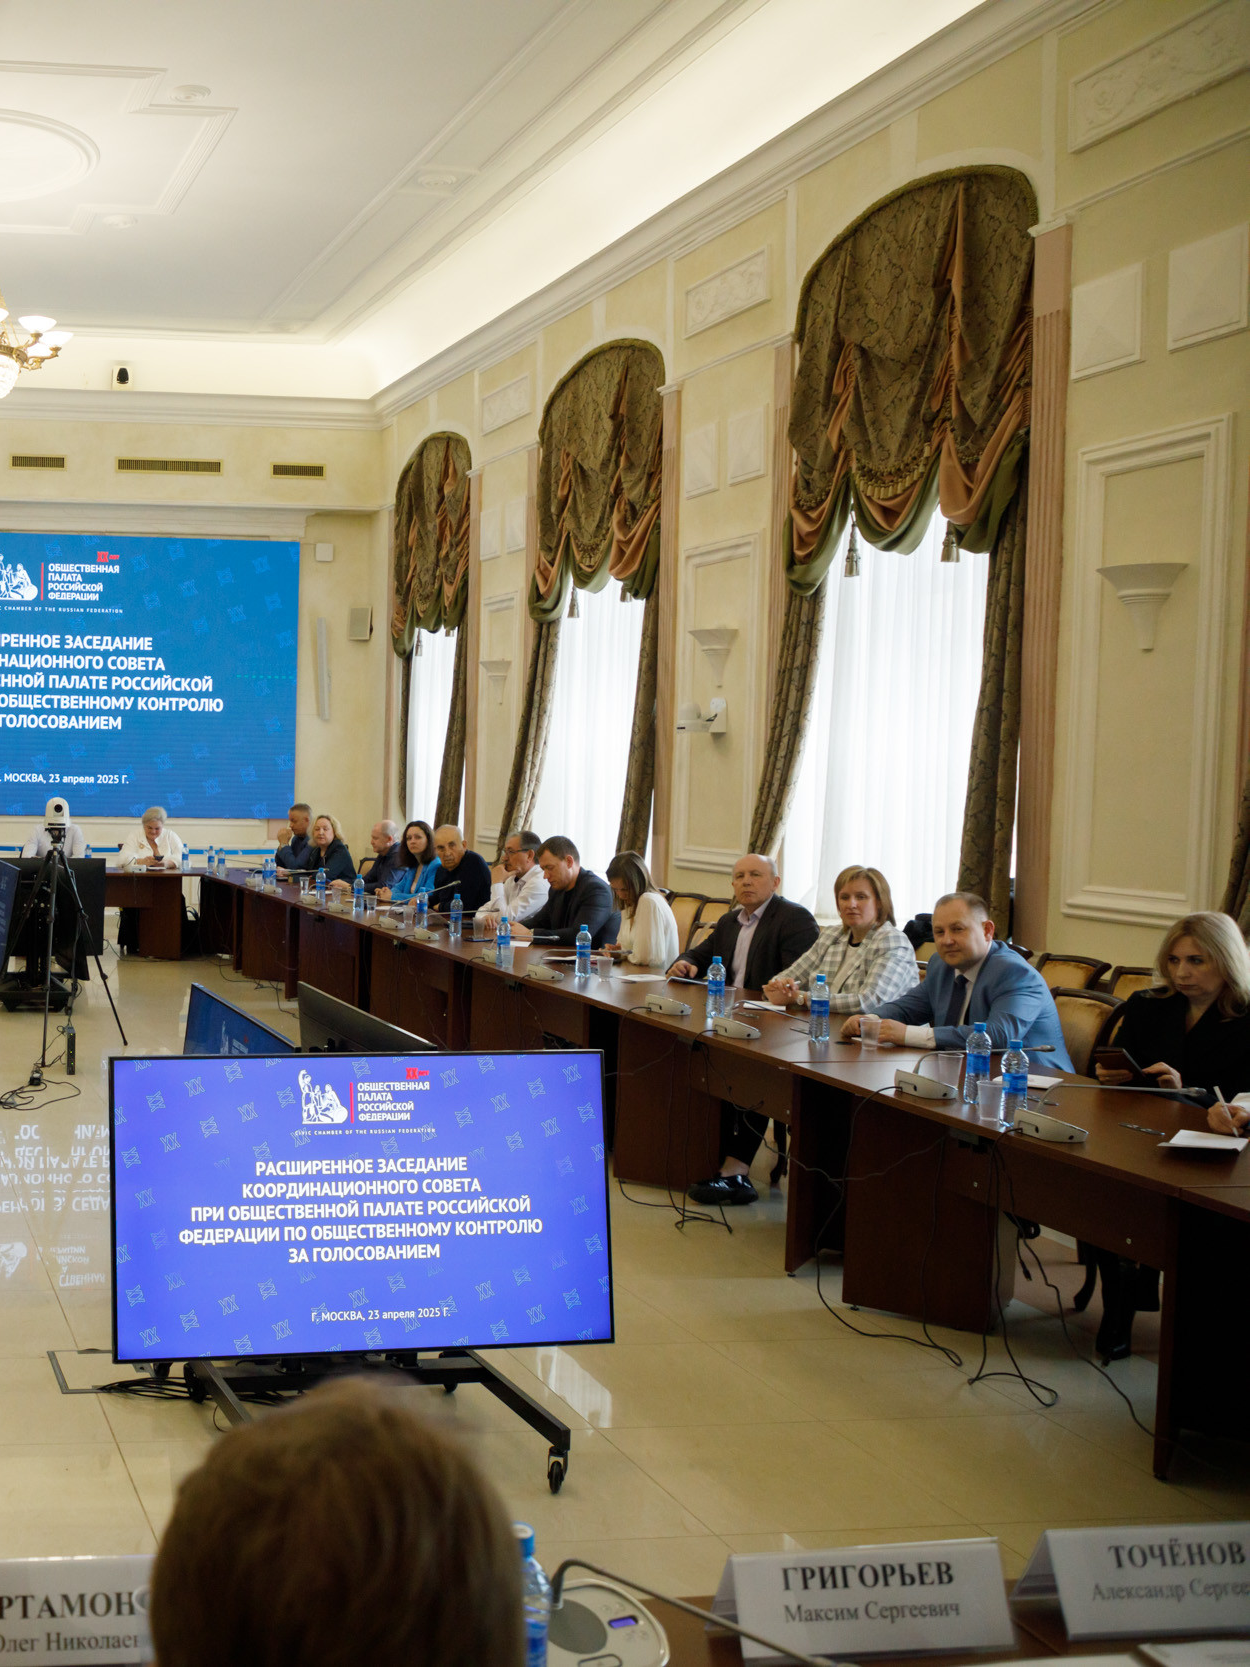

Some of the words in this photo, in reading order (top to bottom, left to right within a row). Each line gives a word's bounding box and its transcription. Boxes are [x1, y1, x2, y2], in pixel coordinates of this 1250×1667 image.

[48, 563, 120, 574] ОБЩЕСТВЕННАЯ
[48, 573, 83, 582] ПАЛАТА
[48, 582, 104, 592] РОССИЙСКОЙ
[48, 592, 99, 601] ФЕДЕРАЦИИ
[64, 634, 153, 653] ЗАСЕДАНИЕ
[107, 655, 165, 672] СОВЕТА
[48, 675, 108, 690] ПАЛАТЕ
[111, 674, 213, 693] РОССИЙСКОЙ
[137, 696, 223, 712] КОНТРОЛЮ
[3, 773, 47, 785] МОСКВА,
[48, 773, 60, 783] 23
[62, 775, 94, 786] апреля
[97, 775, 119, 785] 2025
[121, 775, 129, 785] Г.
[357, 1082, 430, 1092] ОБЩЕСТВЕННАЯ
[357, 1092, 393, 1101] ПАЛАТА
[357, 1101, 414, 1111] РОССИЙСКОЙ
[358, 1112, 411, 1122] ФЕДЕРАЦИИ
[255, 1158, 374, 1176] РАСШИРЕННОЕ
[377, 1156, 467, 1174] ЗАСЕДАНИЕ
[242, 1180, 419, 1199] КООРДИНАЦИОННОГО
[422, 1177, 482, 1194] СОВЕТА
[191, 1206, 225, 1223] ПРИ
[228, 1199, 359, 1222] ОБЩЕСТВЕННОЙ
[363, 1202, 424, 1218] ПАЛАТЕ
[427, 1195, 531, 1215] РОССИЙСКОЙ
[178, 1226, 280, 1246] ФЕДЕРАЦИИ
[284, 1225, 307, 1242] ПО
[310, 1221, 453, 1241] ОБЩЕСТВЕННОМУ
[455, 1218, 543, 1236] КОНТРОЛЮ
[288, 1248, 309, 1264] ЗА
[312, 1244, 441, 1262] ГОЛОСОВАНИЕМ
[311, 1312, 319, 1322] Г.
[321, 1310, 366, 1322] МОСКВА,
[367, 1310, 380, 1320] 23
[382, 1310, 415, 1321] апреля
[417, 1308, 441, 1318] 2025
[443, 1307, 451, 1317] Г.
[1108, 1538, 1246, 1568] ТОЧЁНОВ
[782, 1562, 954, 1590] ГРИГОРЬЕВ
[1092, 1583, 1186, 1603] Александр
[1189, 1578, 1250, 1602] Сергее
[784, 1604, 859, 1623] Максим
[864, 1601, 961, 1624] Сергеевич
